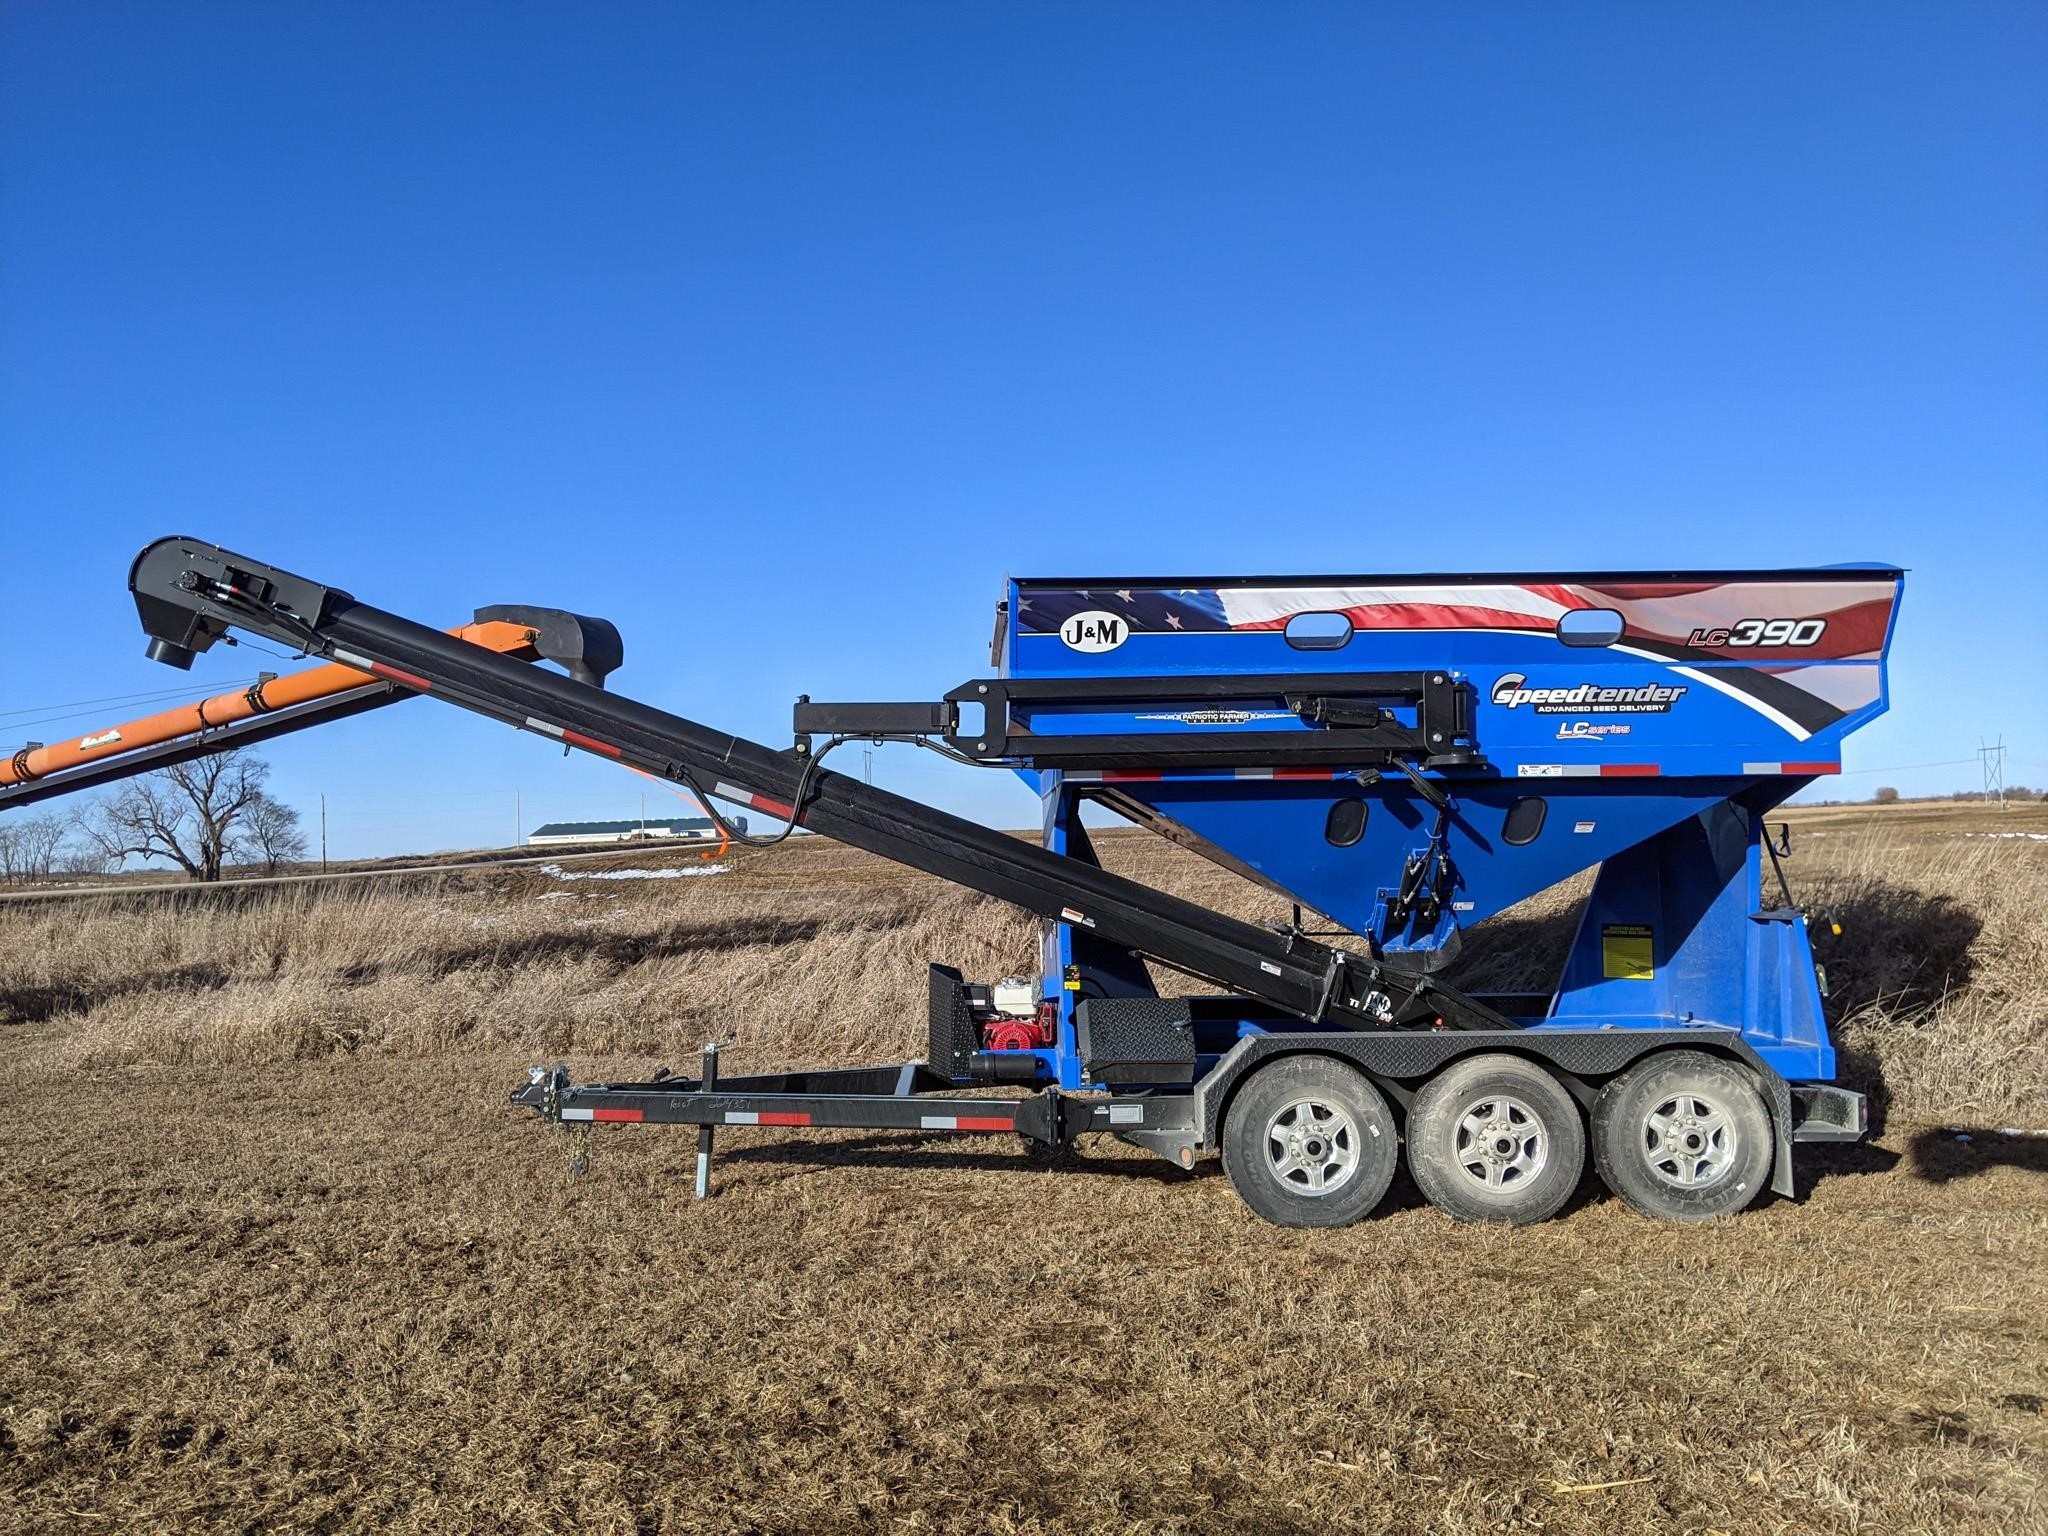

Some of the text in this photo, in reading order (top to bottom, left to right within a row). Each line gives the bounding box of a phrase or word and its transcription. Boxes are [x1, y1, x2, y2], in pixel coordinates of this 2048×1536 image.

[1065, 619, 1119, 645] J&M
[1537, 705, 1591, 713] ADVANCED
[1619, 704, 1666, 712] DELIVERY
